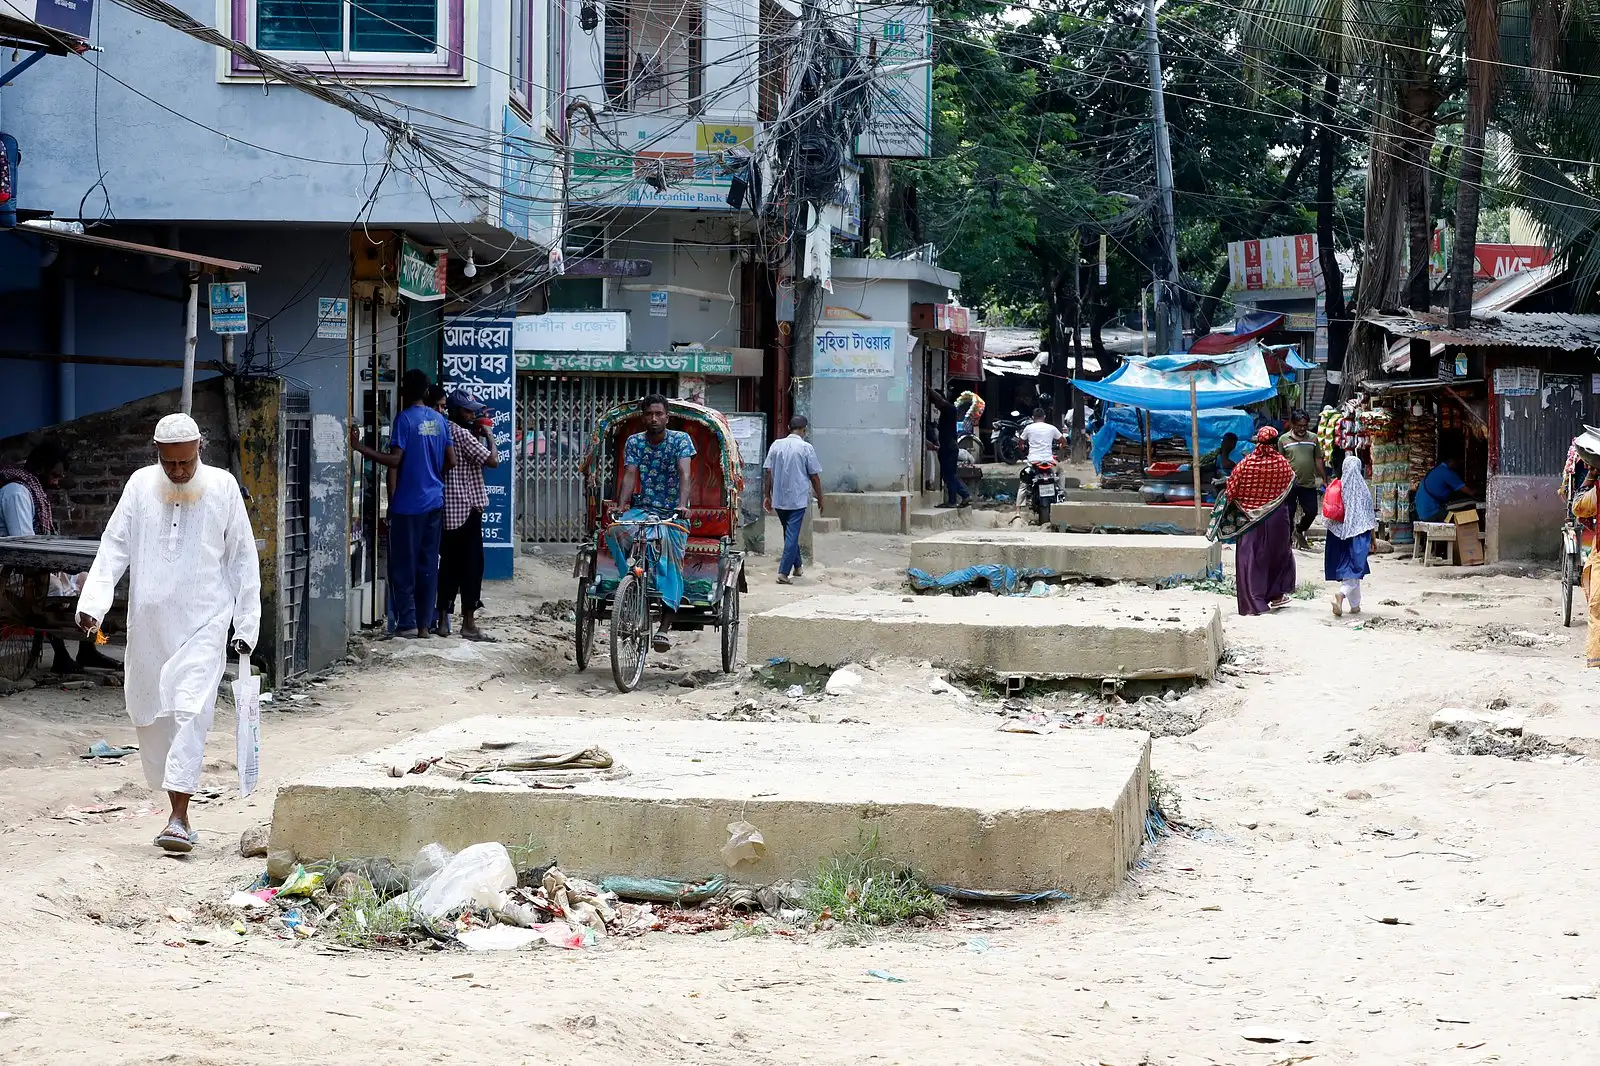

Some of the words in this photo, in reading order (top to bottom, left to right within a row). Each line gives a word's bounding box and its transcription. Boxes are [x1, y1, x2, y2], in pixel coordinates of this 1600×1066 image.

[712, 129, 739, 144] Ria
[642, 190, 695, 201] Mercantile
[697, 192, 723, 202] Bank
[444, 326, 511, 349] আল-হেরা
[816, 331, 849, 354] সুহিতা
[852, 332, 891, 351] টাওয়ার
[443, 354, 479, 379] সুতা
[480, 353, 508, 375] ঘর
[621, 353, 689, 371] হাউজ
